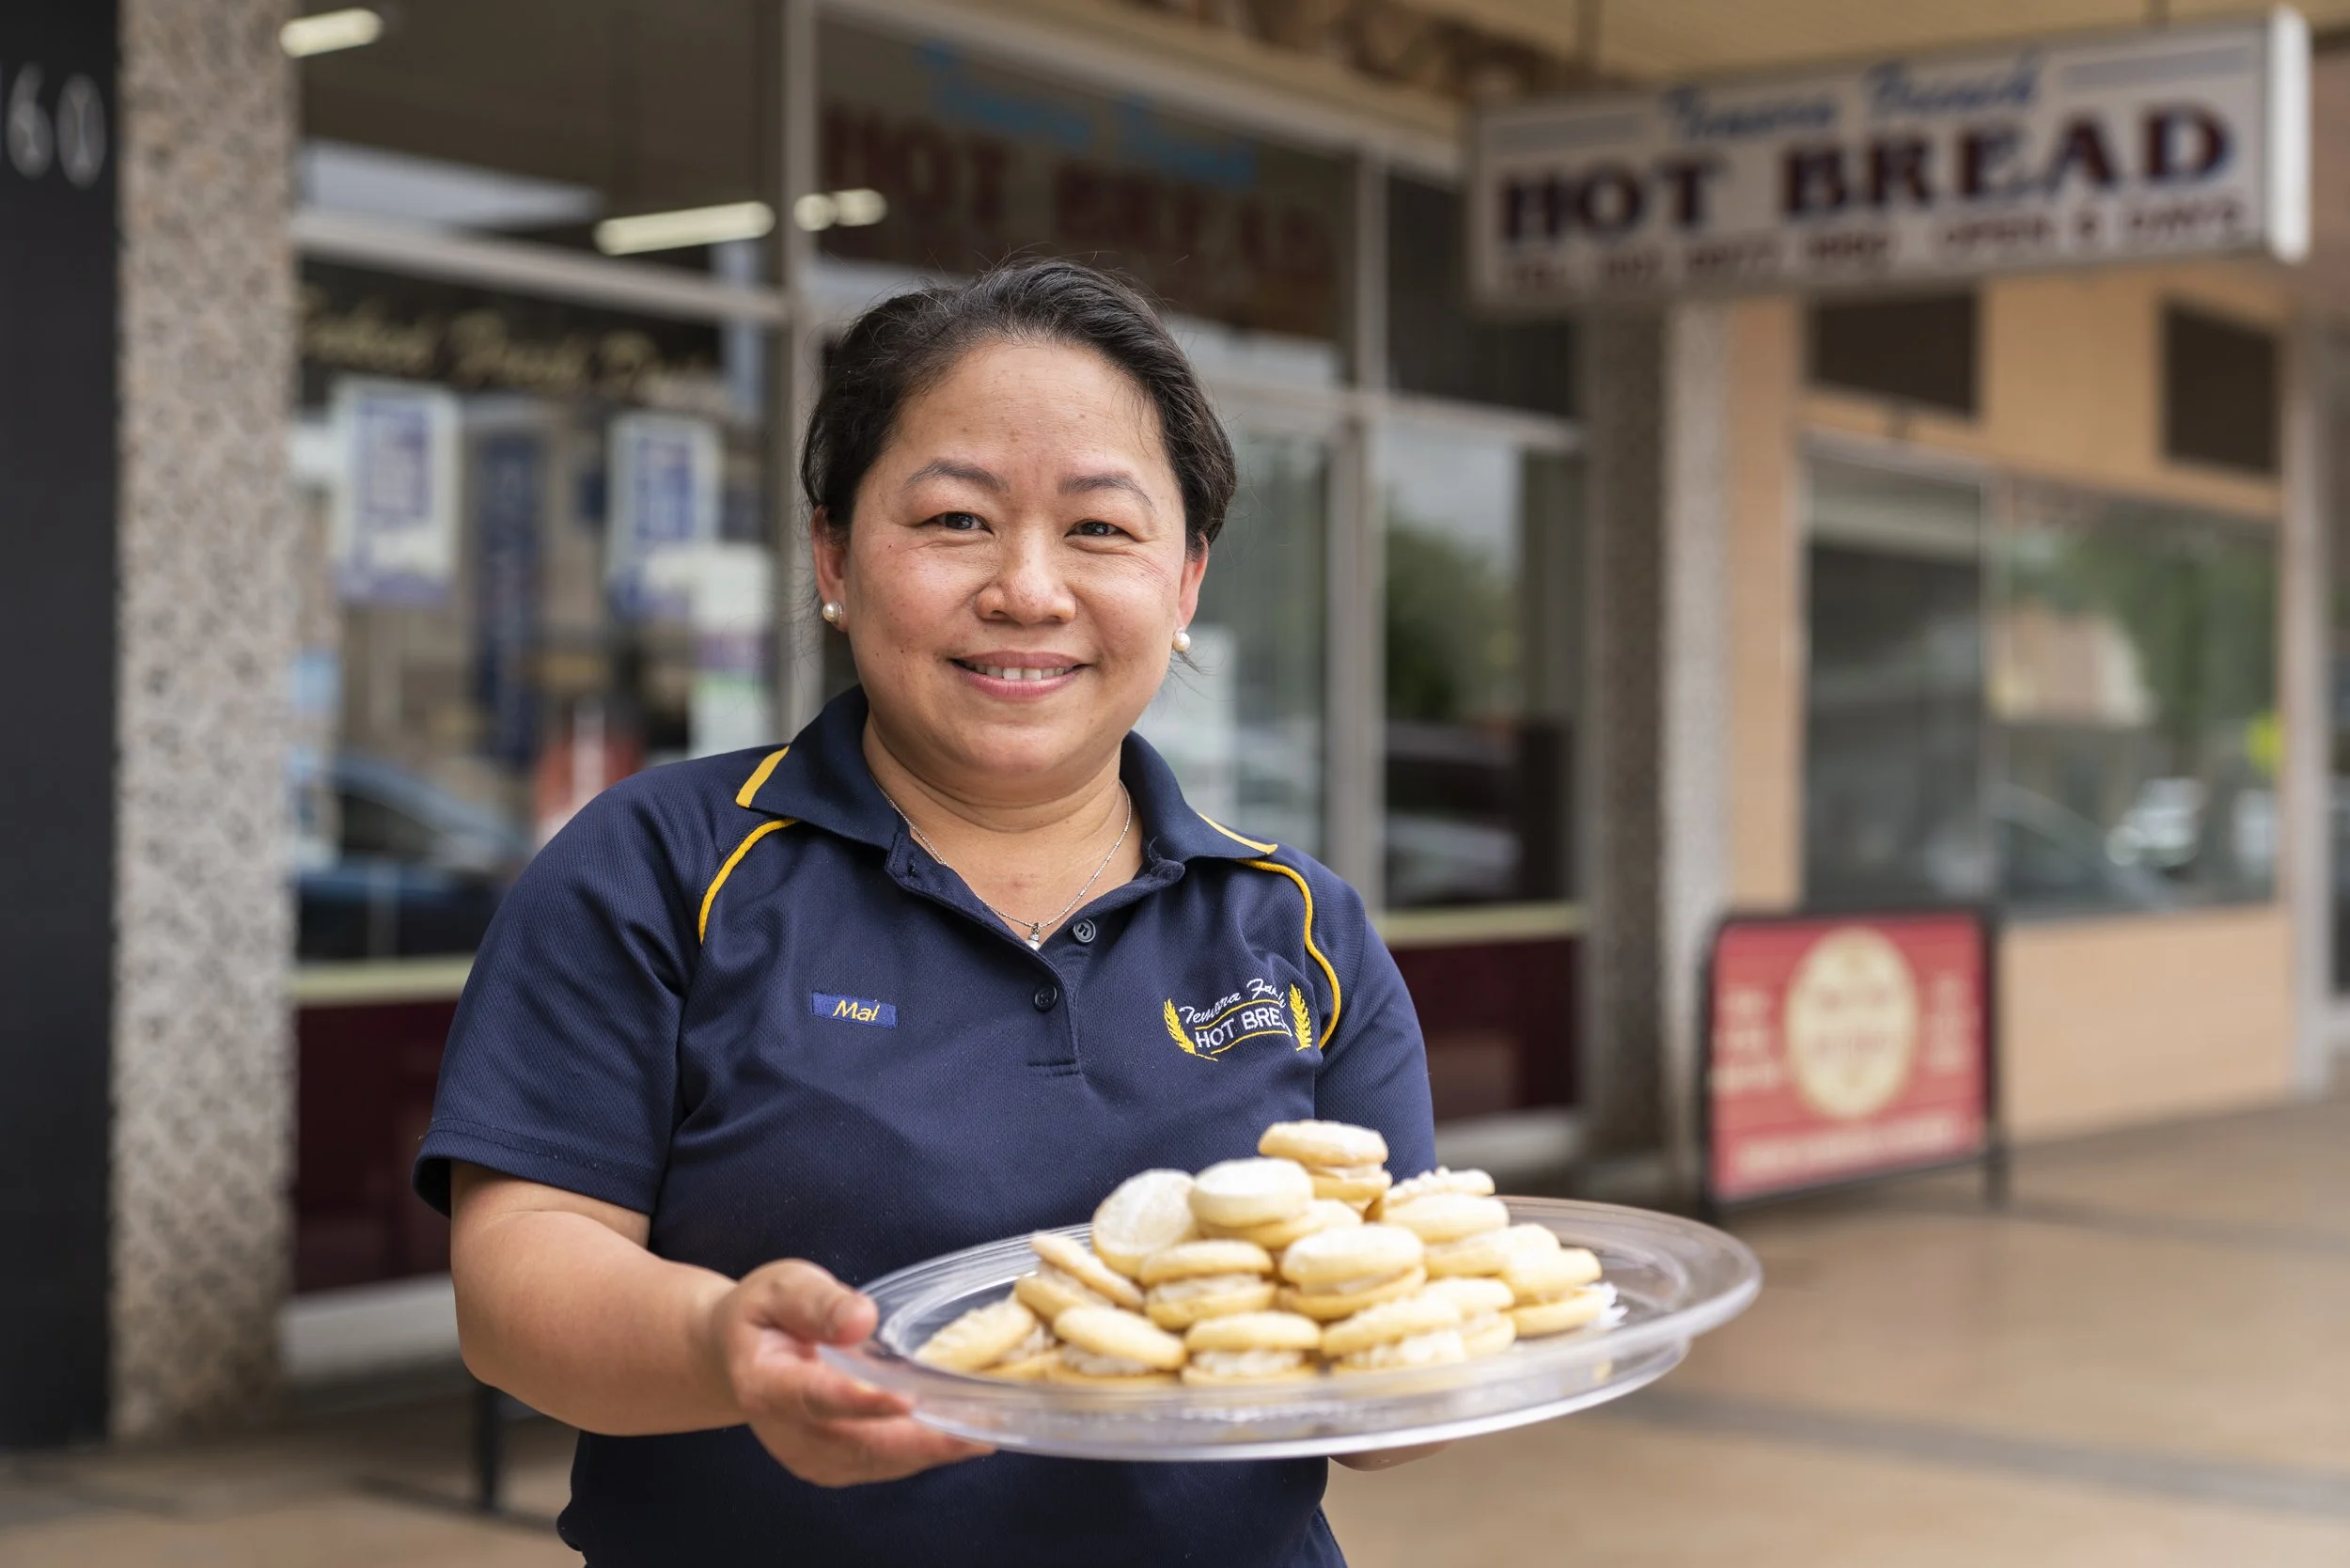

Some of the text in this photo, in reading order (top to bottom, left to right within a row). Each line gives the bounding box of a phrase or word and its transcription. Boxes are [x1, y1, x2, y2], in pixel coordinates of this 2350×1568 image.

[0, 60, 106, 189] 60
[1498, 103, 2239, 248] HOT BREAD
[832, 999, 880, 1022] Mai
[1195, 1007, 1292, 1048] HOT BRE
